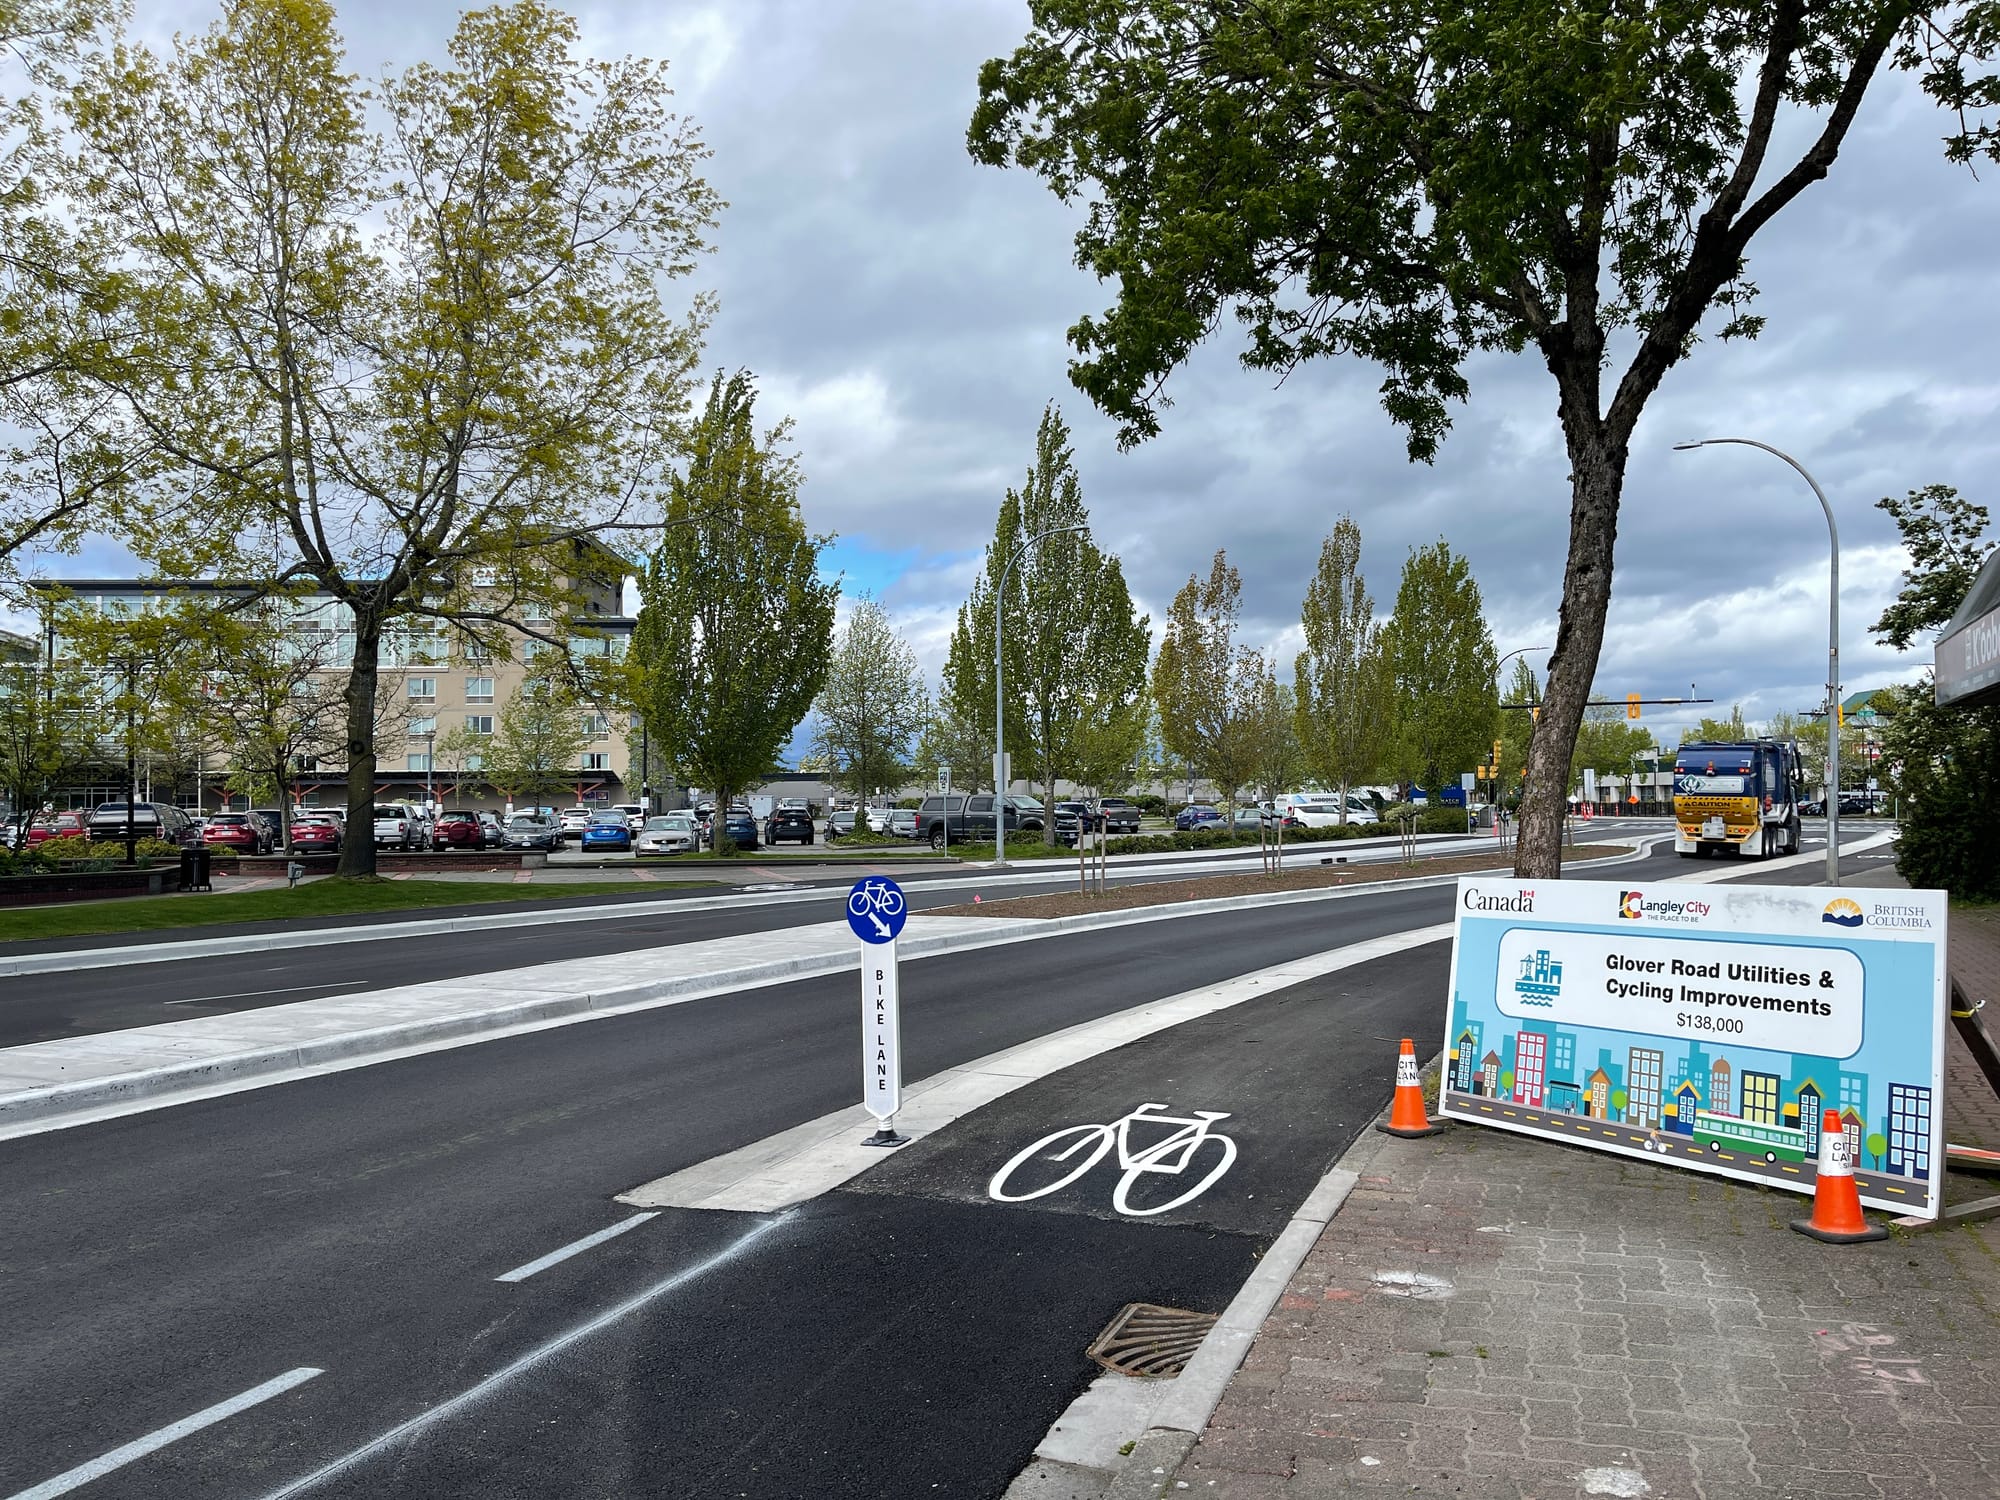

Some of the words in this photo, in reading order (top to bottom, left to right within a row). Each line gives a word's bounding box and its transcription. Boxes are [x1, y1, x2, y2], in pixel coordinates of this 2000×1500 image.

[1464, 888, 1535, 913] Canada
[1640, 900, 1685, 915] Langley
[1686, 901, 1711, 916] City
[1874, 904, 1924, 916] BRITISH
[1866, 915, 1932, 928] COLUMBIA
[1606, 954, 1665, 974] Glover
[1671, 959, 1720, 979] Road
[1727, 963, 1811, 986] Utilities
[1818, 970, 1835, 989] &
[875, 969, 885, 1025] BIKE
[1606, 978, 1674, 1003] Cycling
[1680, 985, 1832, 1016] Improvements
[1676, 1012, 1744, 1034] $138,000
[877, 1034, 887, 1091] LANE
